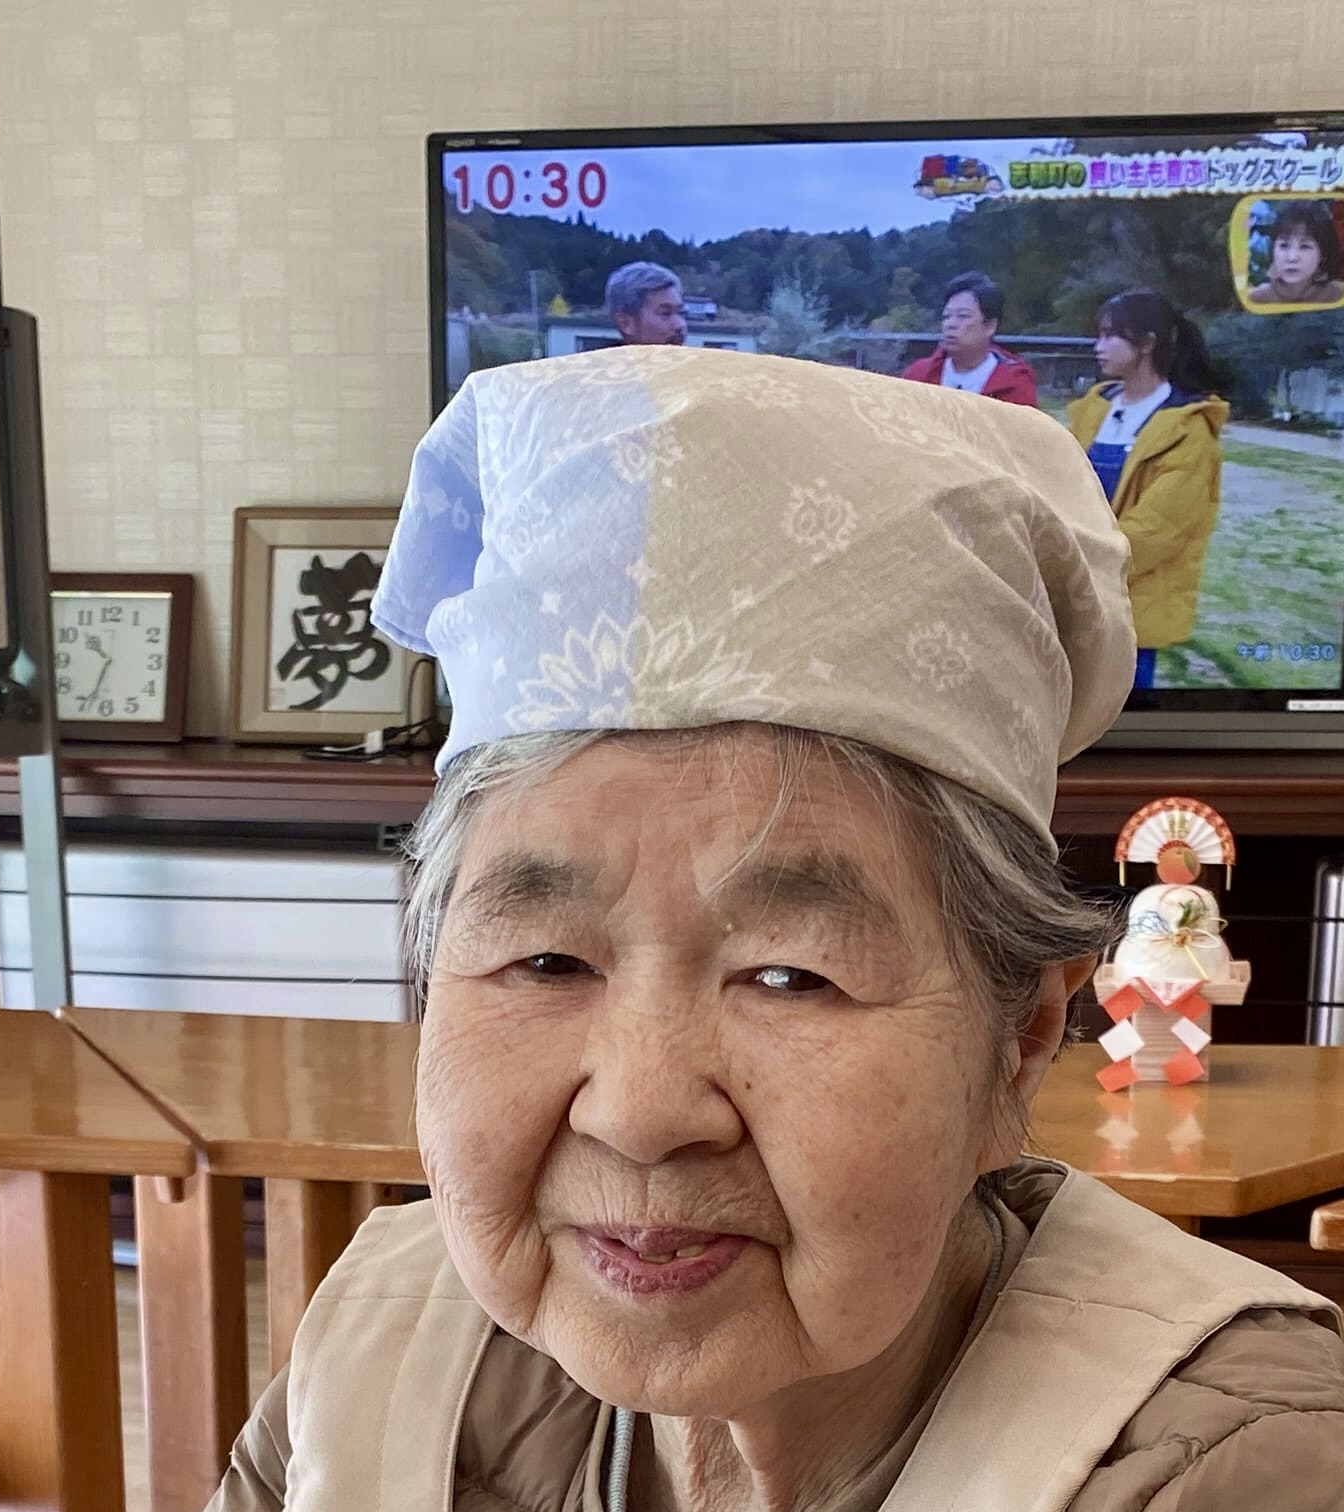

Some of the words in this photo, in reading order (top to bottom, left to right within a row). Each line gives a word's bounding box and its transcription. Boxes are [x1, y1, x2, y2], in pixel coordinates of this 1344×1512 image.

[452, 161, 607, 210] 10:30
[78, 608, 93, 626] 11
[100, 606, 123, 623] 12
[131, 610, 140, 626] 1
[58, 627, 79, 644] 10
[145, 627, 161, 644] 2
[276, 551, 391, 711] 夢
[56, 652, 71, 669] 9
[146, 653, 163, 671] 3
[57, 676, 72, 695] 8
[141, 680, 156, 697] 4
[75, 696, 89, 712] 7
[97, 699, 114, 717] 6
[123, 697, 140, 714] 5
